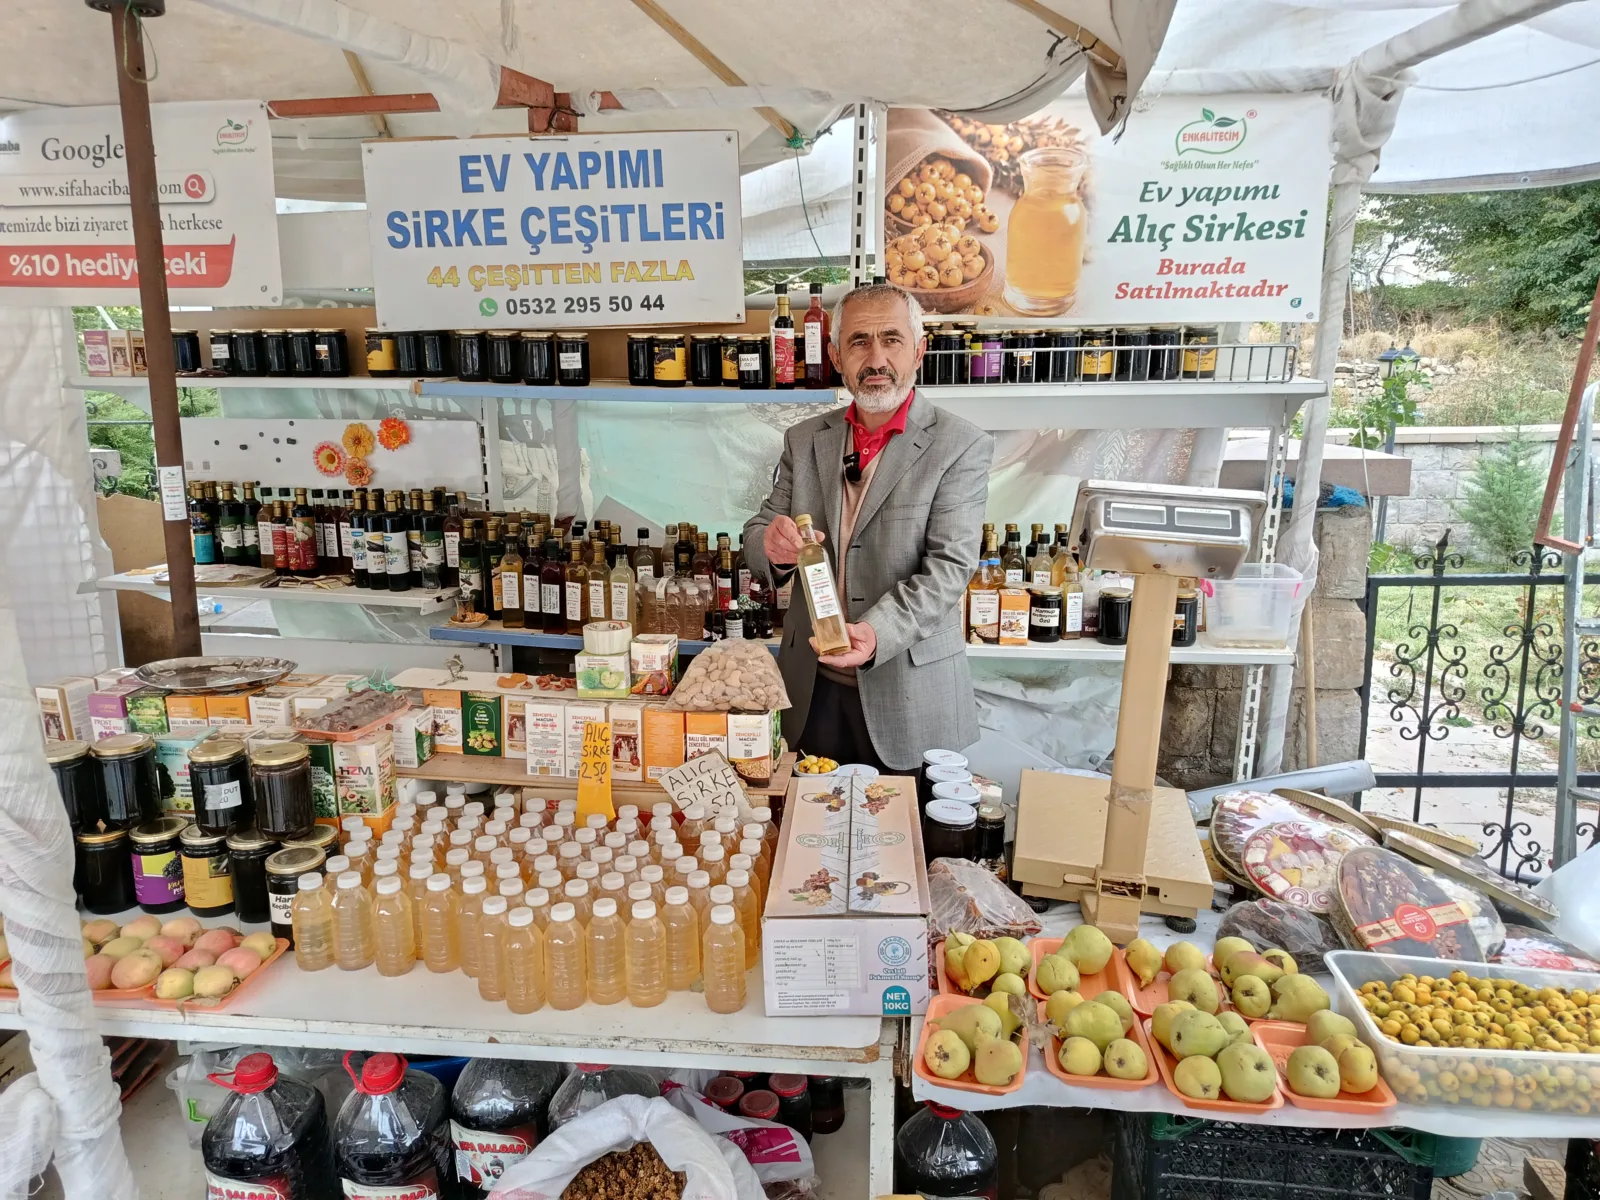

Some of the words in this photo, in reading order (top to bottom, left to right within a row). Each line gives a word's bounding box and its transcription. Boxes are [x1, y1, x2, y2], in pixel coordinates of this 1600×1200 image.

[41, 134, 124, 168] Google
[459, 153, 512, 194] EV
[523, 149, 664, 191] YAPIMI
[1216, 160, 1231, 169] Her
[1139, 180, 1172, 202] Ev
[1175, 184, 1280, 207] yapımı
[54, 215, 80, 232] bizi
[83, 216, 128, 236] ziyaret
[168, 212, 223, 231] herkese
[1107, 214, 1176, 252] Alıç
[1182, 209, 1308, 242] Sirkesi
[10, 254, 60, 277] %10
[427, 265, 460, 287] 44
[610, 259, 695, 283] FAZLA
[1156, 256, 1246, 275] Burada
[1114, 279, 1288, 299] Satılmaktadır
[506, 298, 557, 315] 0532
[564, 296, 601, 313] 295
[608, 295, 633, 312] 50
[640, 294, 665, 311] 44
[584, 723, 610, 744] ALIÇ
[223, 786, 238, 795] DUT
[883, 1002, 909, 1010] 10KG
[886, 992, 907, 1001] NET
